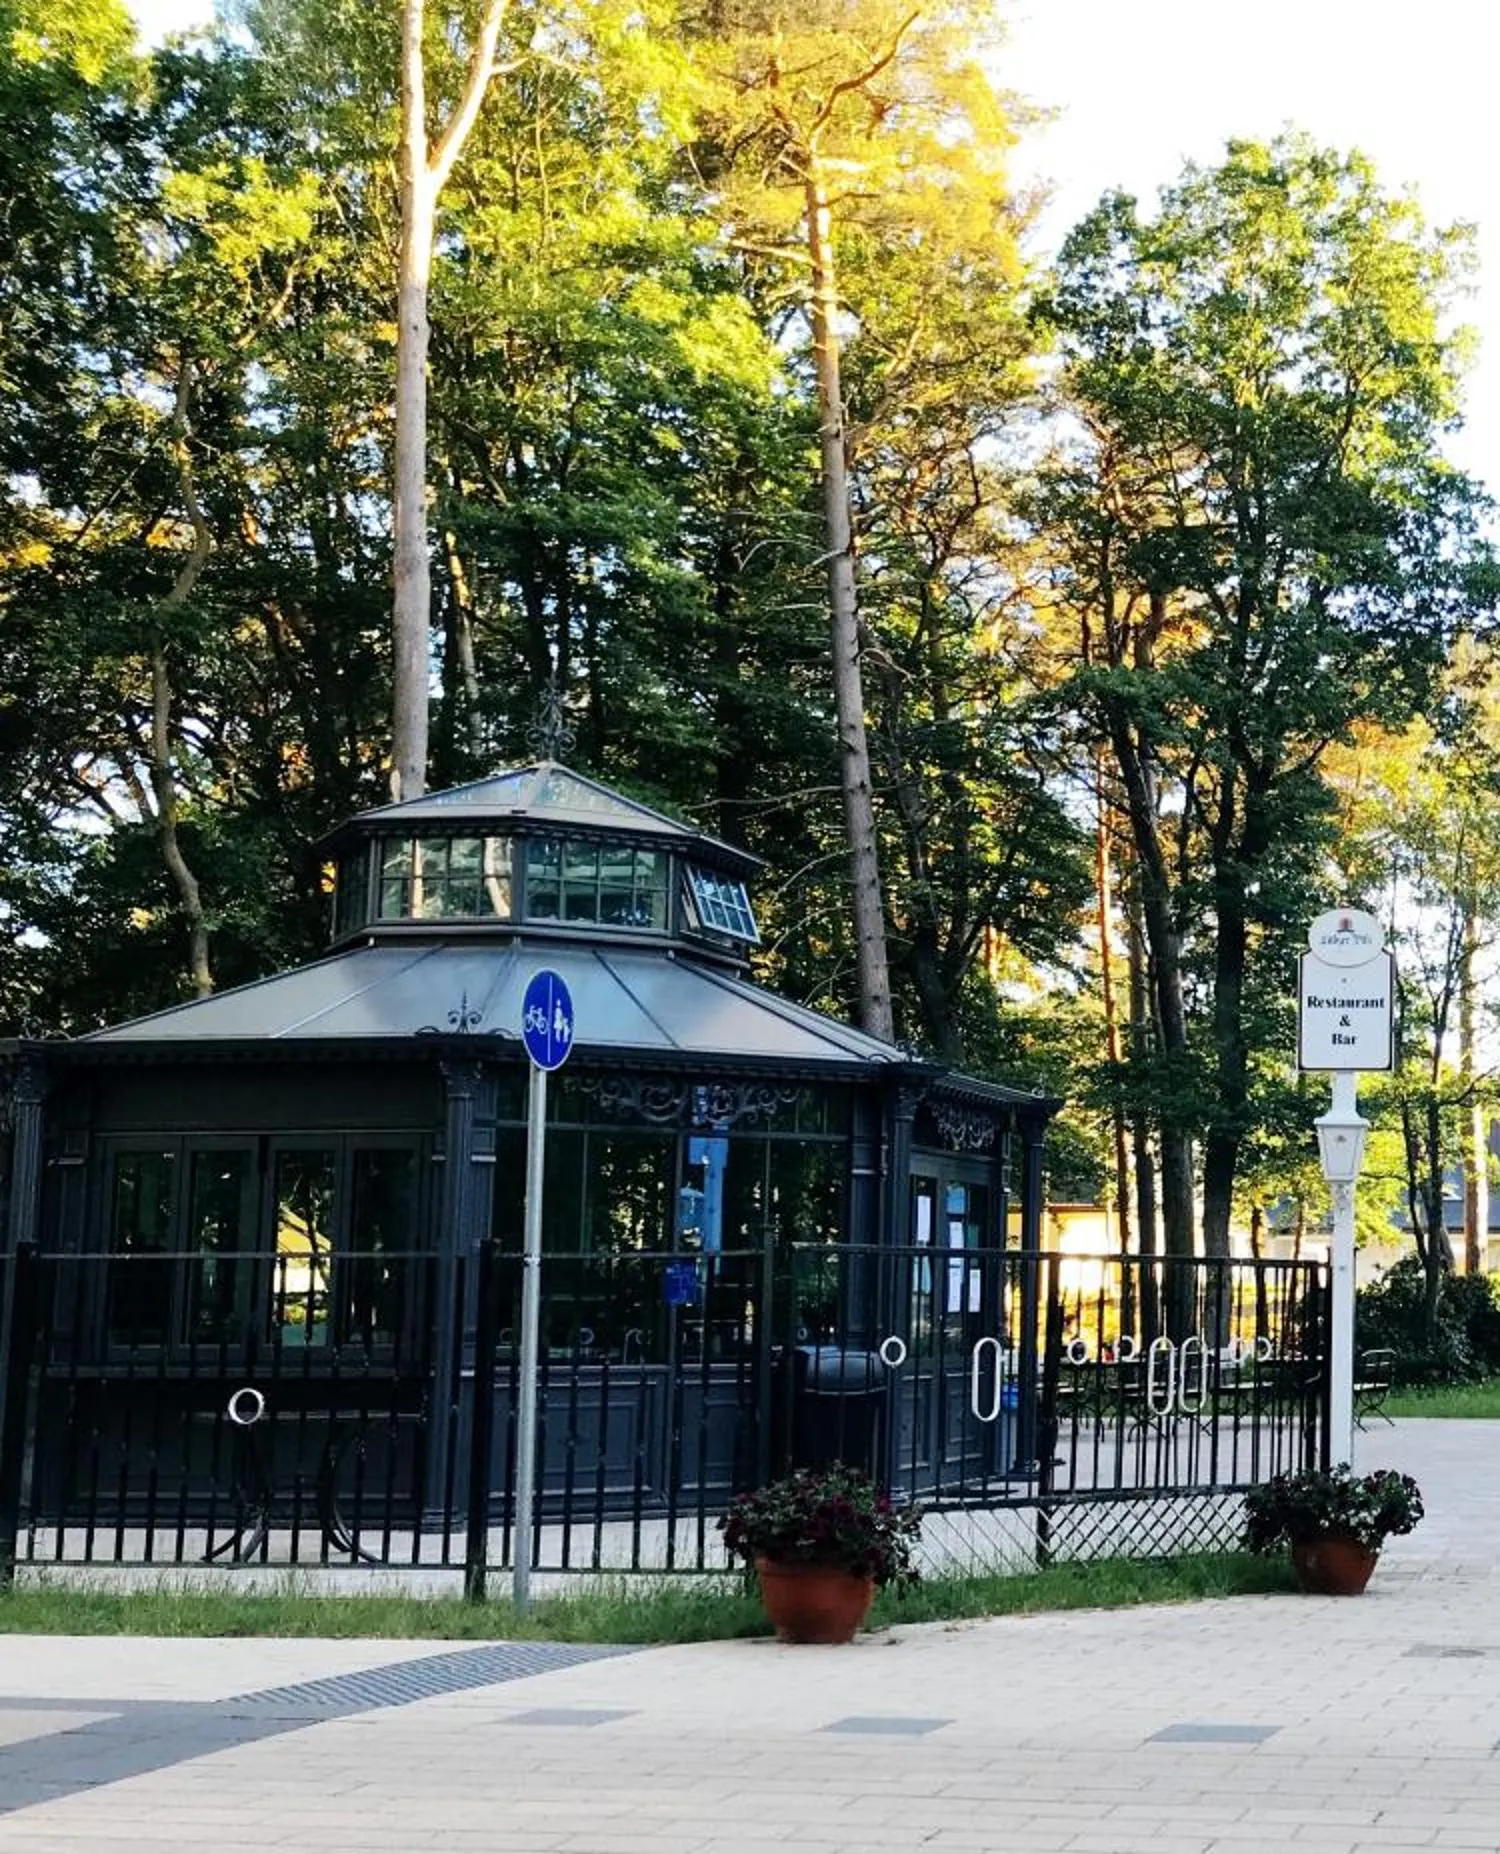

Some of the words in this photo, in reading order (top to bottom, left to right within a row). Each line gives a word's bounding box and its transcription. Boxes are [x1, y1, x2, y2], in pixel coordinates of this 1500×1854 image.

[1307, 996, 1385, 1009] Restaurant
[1339, 1015, 1351, 1027] &
[1331, 1034, 1357, 1045] Bar
